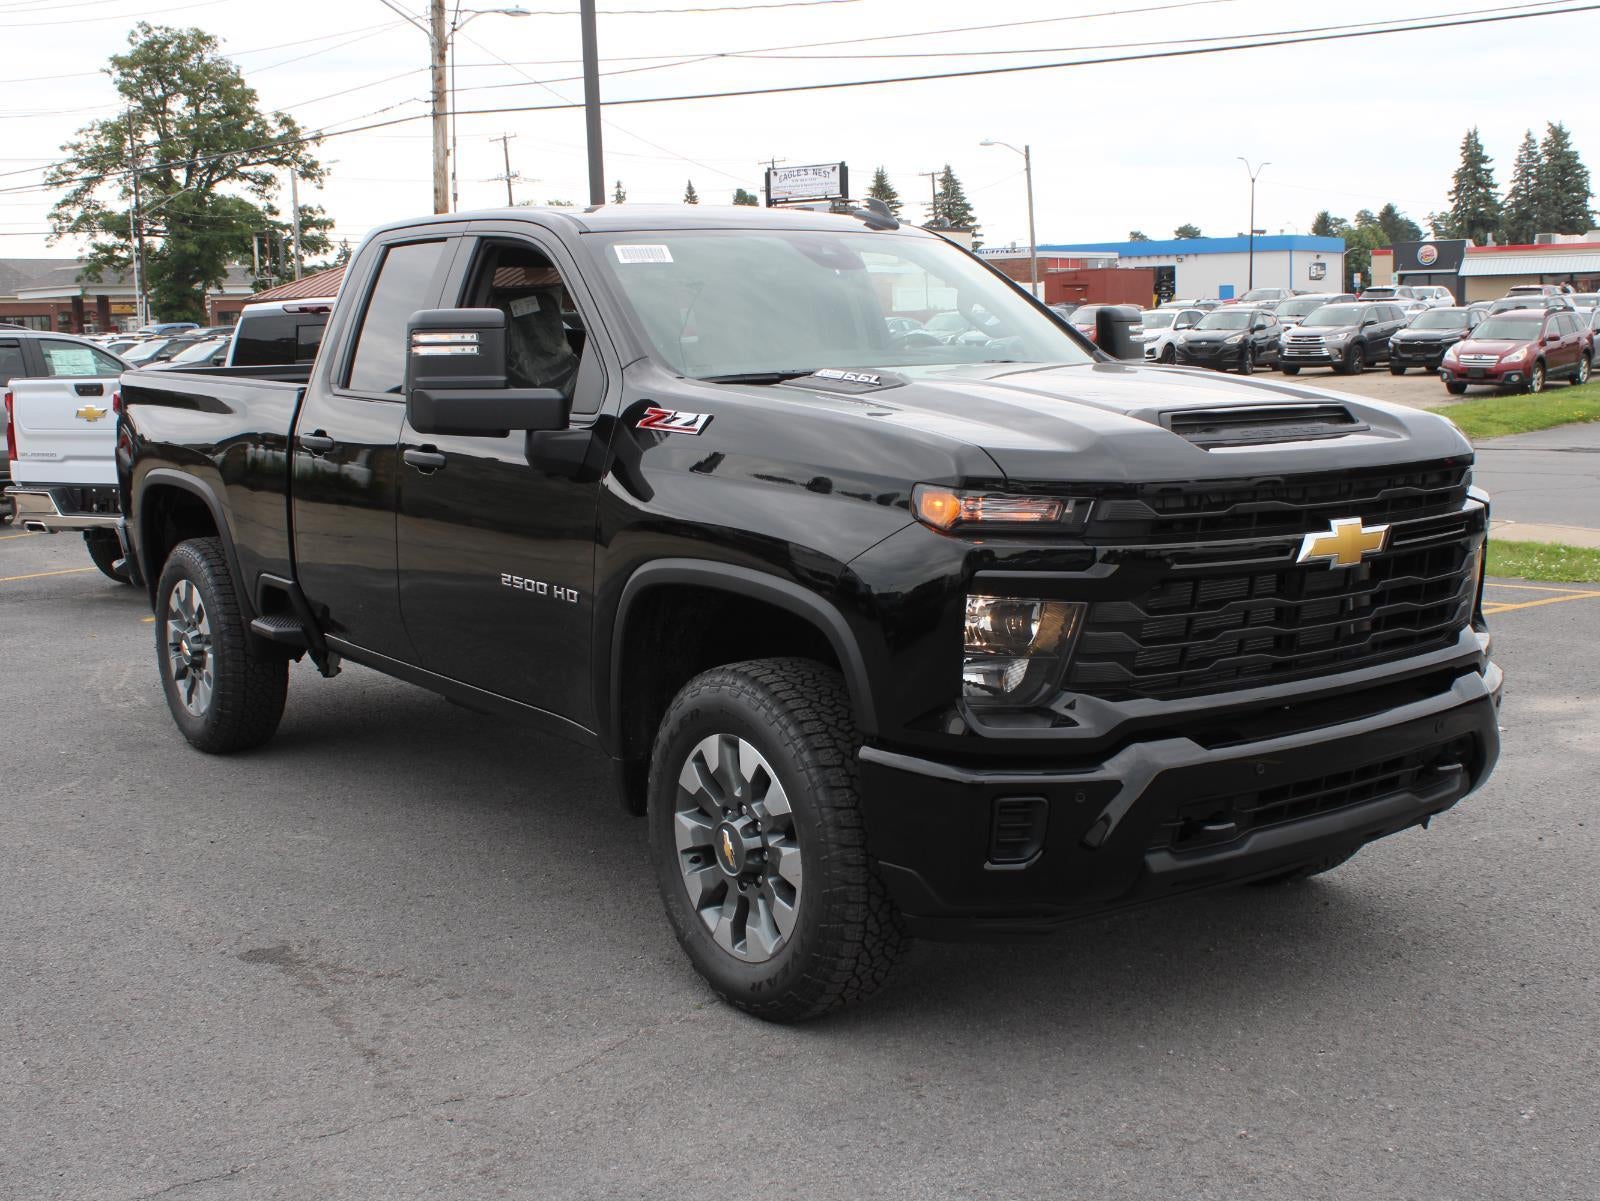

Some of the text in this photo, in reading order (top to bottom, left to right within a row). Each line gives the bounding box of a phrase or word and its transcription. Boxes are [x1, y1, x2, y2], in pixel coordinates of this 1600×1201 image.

[779, 168, 830, 183] EAGLE'S NEST
[636, 407, 713, 435] Z71
[501, 573, 578, 603] 2500 HD
